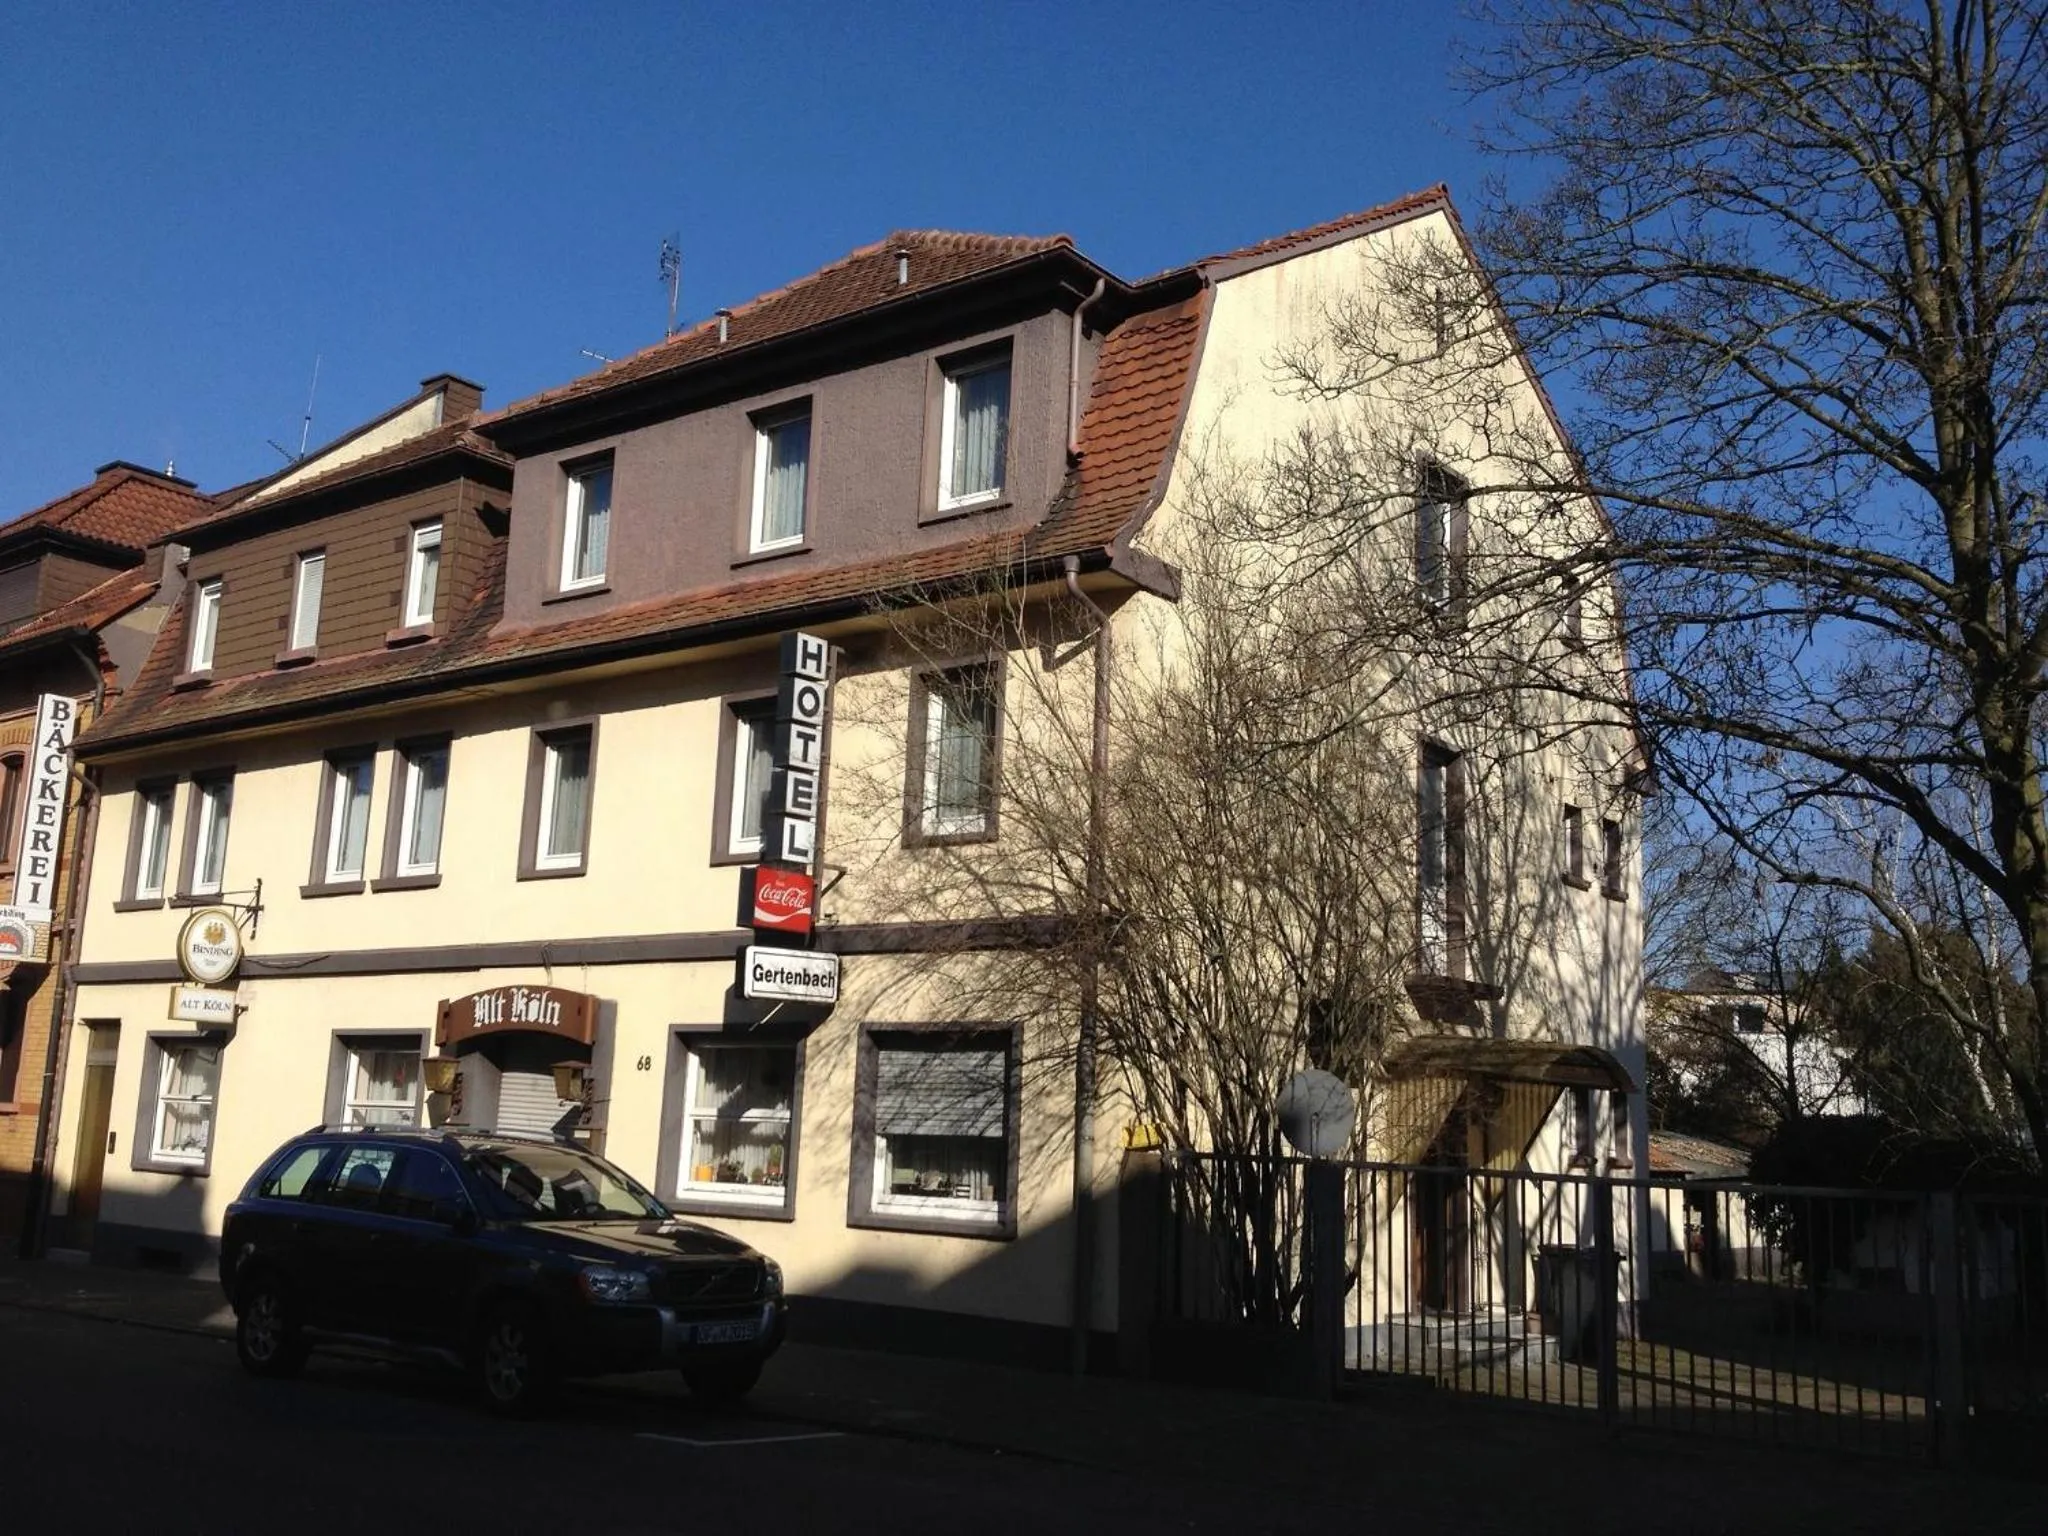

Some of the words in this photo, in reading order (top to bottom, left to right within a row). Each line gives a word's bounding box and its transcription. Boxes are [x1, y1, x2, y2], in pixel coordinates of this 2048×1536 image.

[787, 639, 823, 858] HOTEL
[28, 698, 71, 904] BÄCKEREI
[752, 964, 835, 988] Gertenbach
[181, 1000, 201, 1010] ALT
[203, 999, 231, 1011] KÖLN
[472, 991, 505, 1028] Alt
[510, 987, 561, 1027] Köln
[637, 1055, 652, 1071] 68
